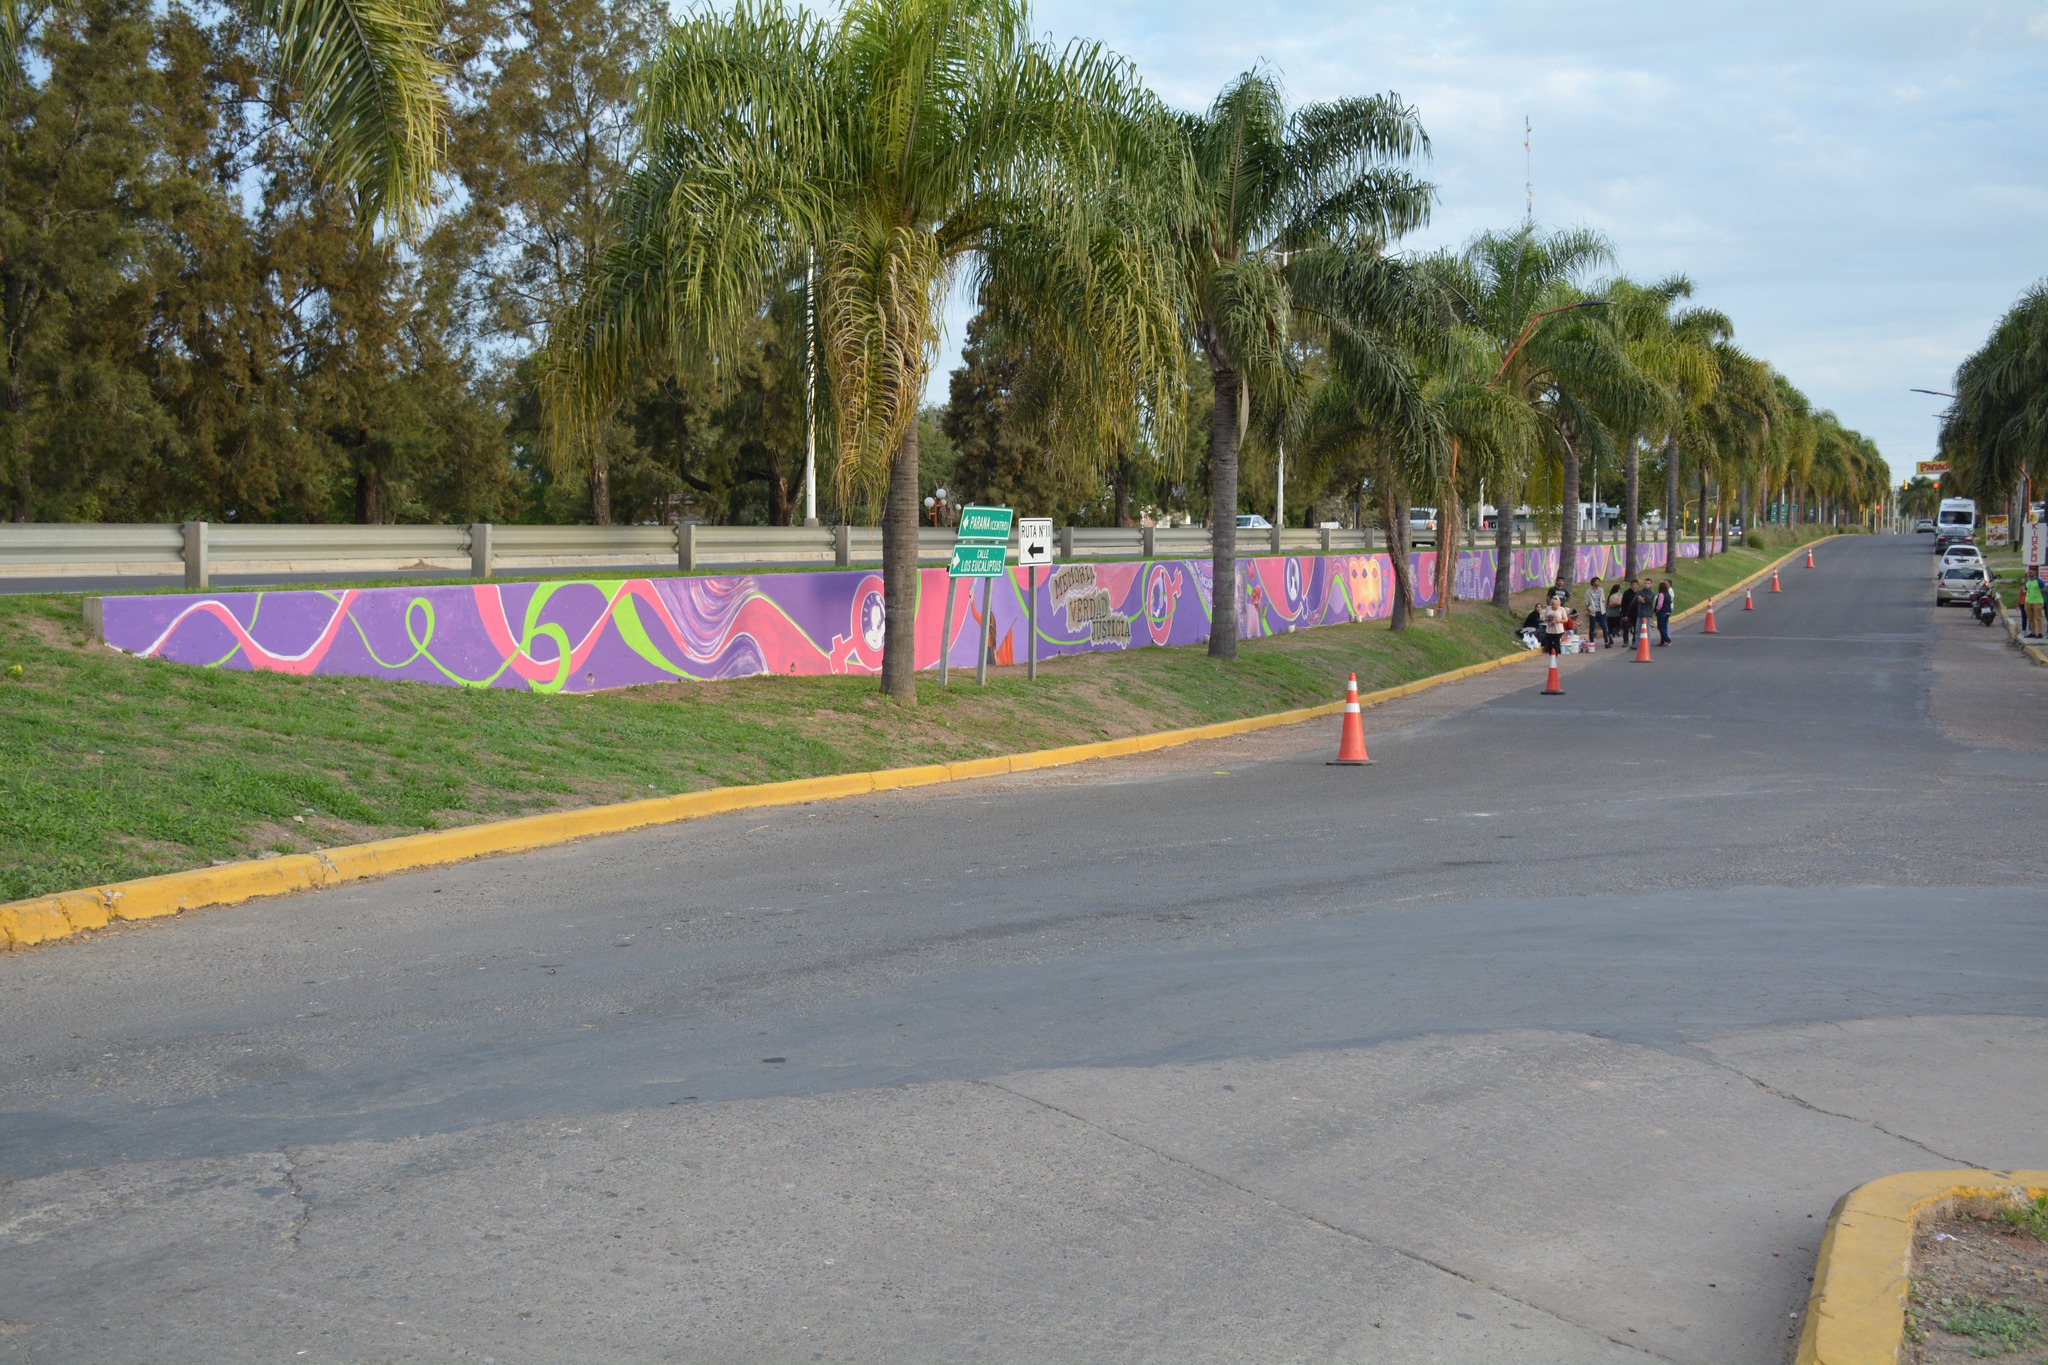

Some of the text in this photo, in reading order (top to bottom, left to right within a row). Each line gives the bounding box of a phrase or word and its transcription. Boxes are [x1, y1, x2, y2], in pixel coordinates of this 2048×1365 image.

[970, 516, 990, 530] PARANA
[1021, 525, 1037, 538] RUTA
[977, 549, 989, 559] CALLE
[961, 560, 1001, 572] LOS EUCALIPTUS
[1054, 565, 1095, 599] MEMORIA
[1070, 597, 1107, 622] VERDAD
[1092, 619, 1130, 640] JUSTICIA
